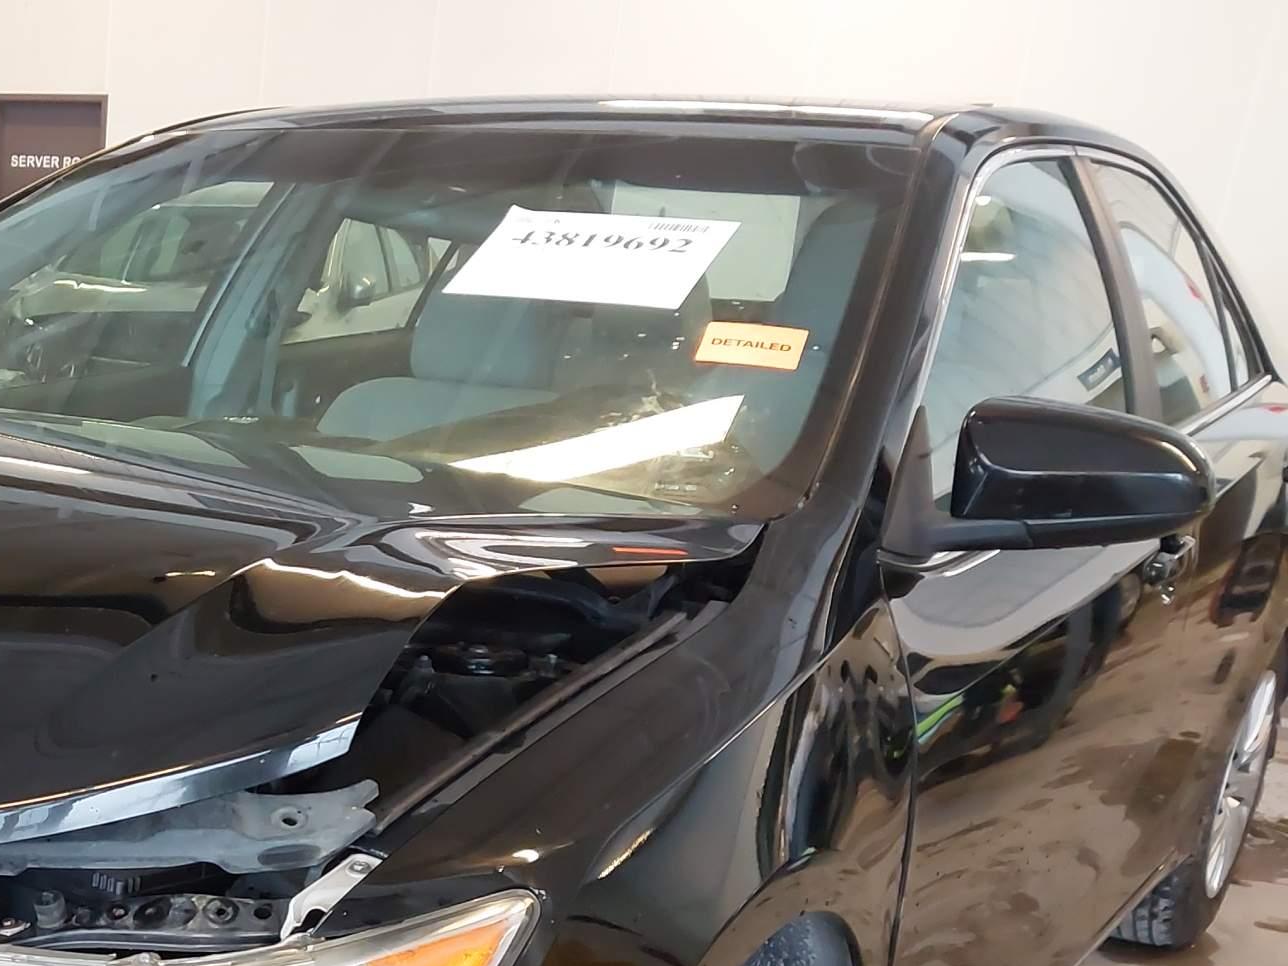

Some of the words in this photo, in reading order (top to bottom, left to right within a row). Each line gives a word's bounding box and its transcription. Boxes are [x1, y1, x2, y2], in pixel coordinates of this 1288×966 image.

[11, 155, 60, 168] SERVER
[512, 231, 693, 253] 43819692
[711, 337, 792, 352] DETAILED
